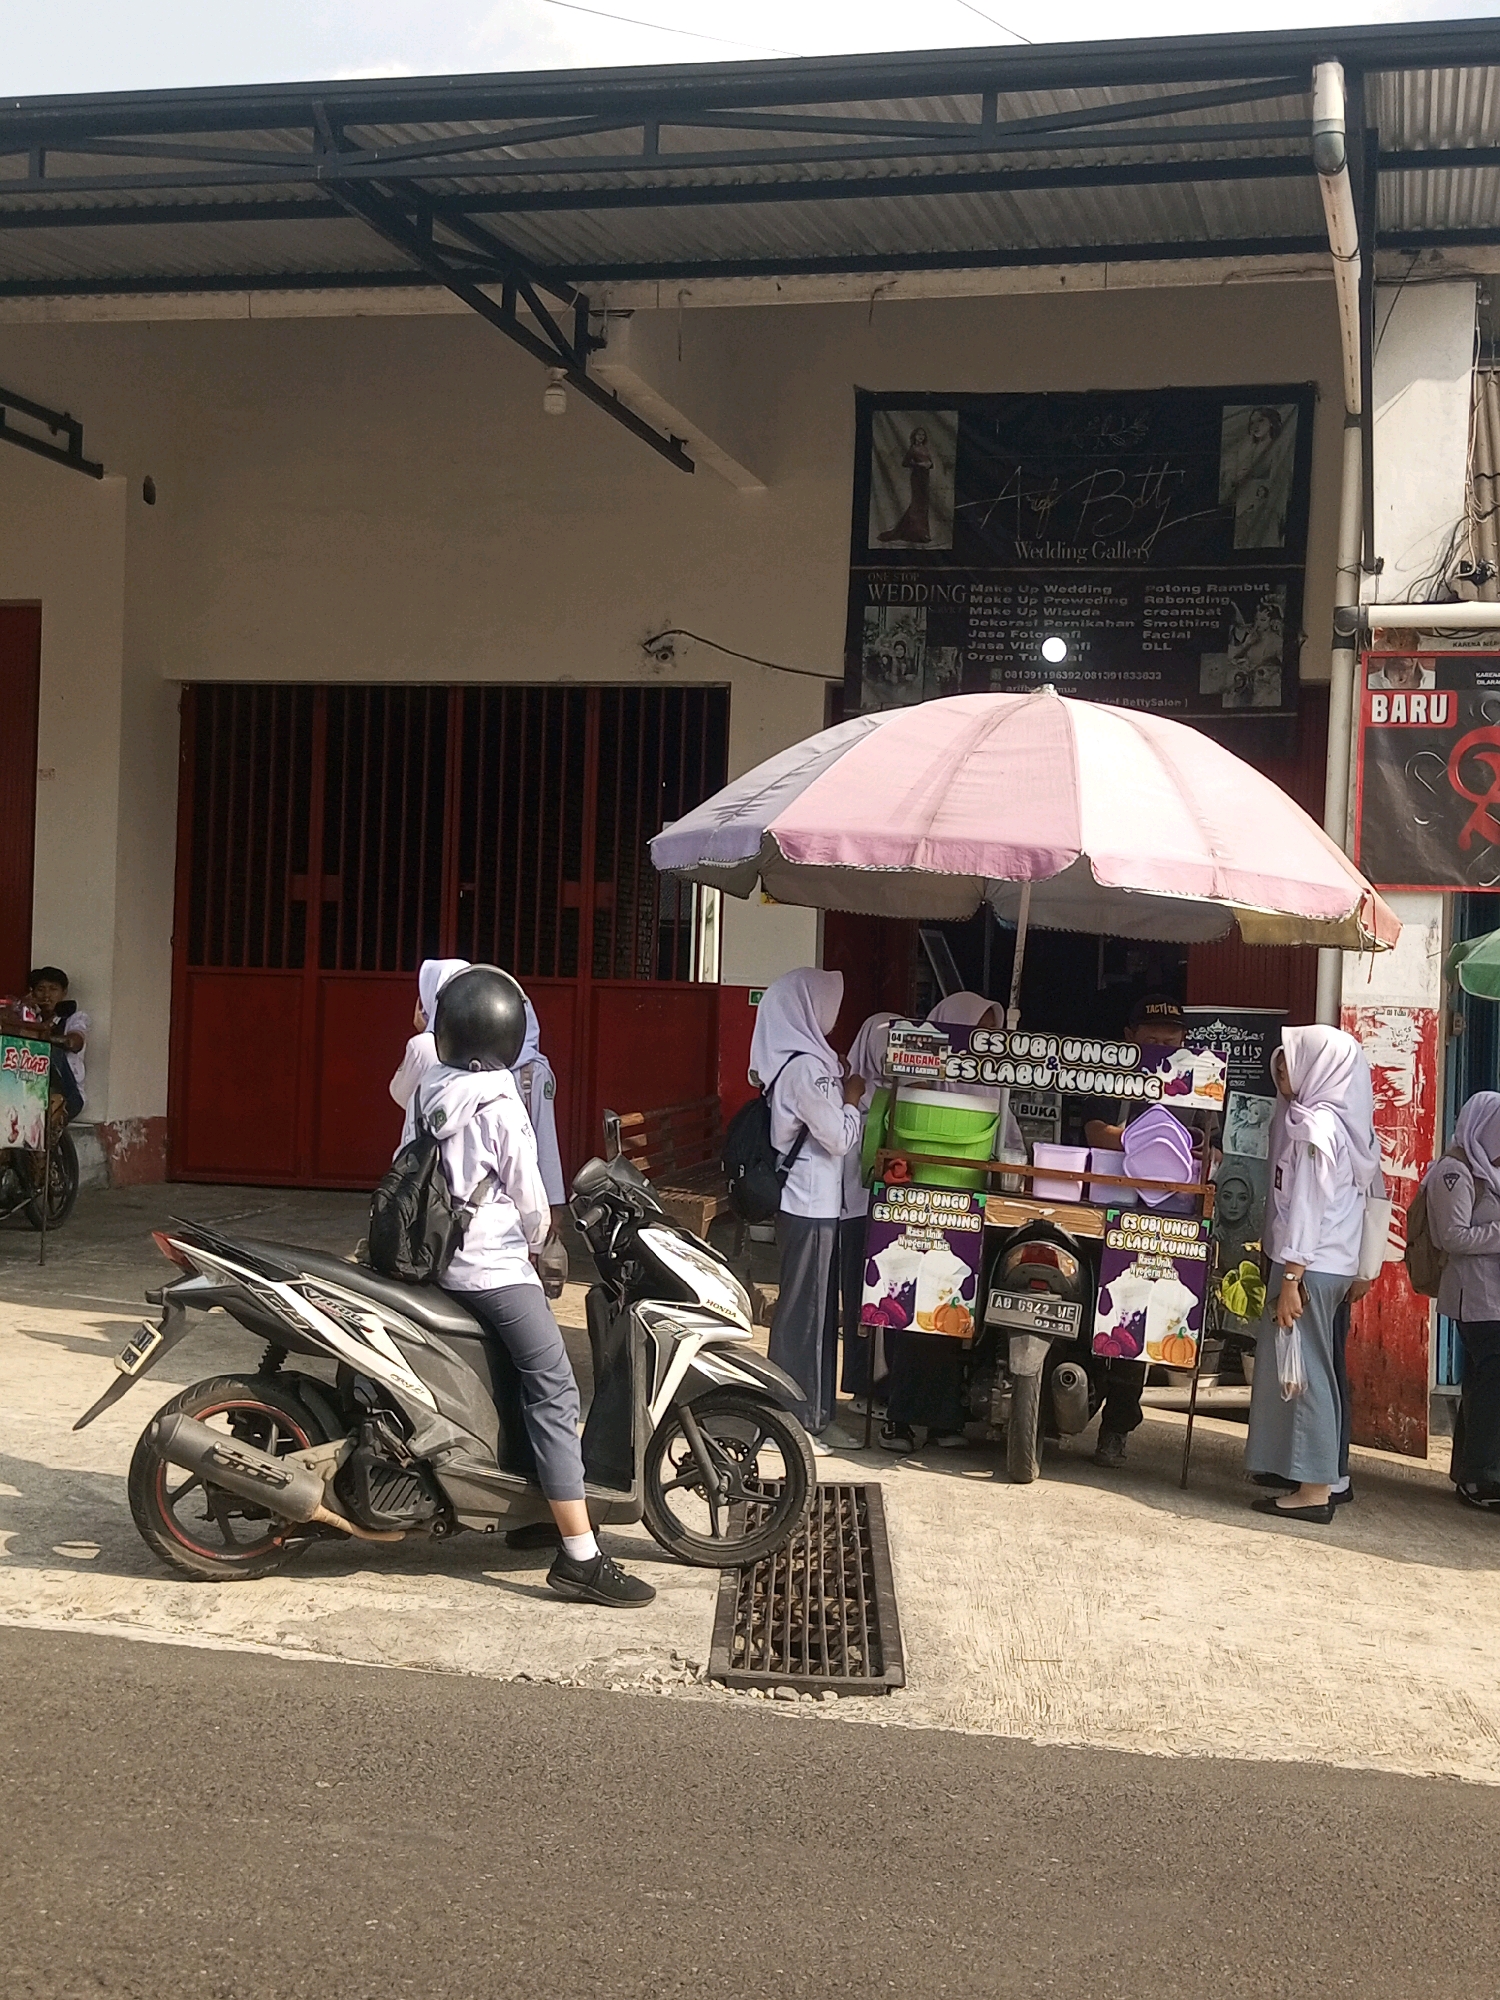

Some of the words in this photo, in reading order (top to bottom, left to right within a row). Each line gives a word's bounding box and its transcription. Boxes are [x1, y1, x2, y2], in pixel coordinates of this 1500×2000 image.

[1014, 540, 1088, 563] Wedding
[1091, 540, 1151, 564] Gallery
[867, 572, 888, 581] ONE
[893, 572, 920, 582] STOP
[868, 583, 968, 603] WEDDING
[970, 584, 1013, 593] Make
[1018, 584, 1040, 595] Up
[1043, 584, 1113, 595] Wedding
[1145, 584, 1202, 595] Potong
[1206, 582, 1270, 593] Rambut
[969, 595, 1013, 604] Make
[1017, 595, 1039, 606] Up
[1144, 595, 1231, 605] Rebonding
[969, 606, 1012, 616] Make
[1016, 606, 1038, 618] Up
[1043, 607, 1101, 617] Wisuda
[968, 618, 1038, 627] Dekorasi
[1043, 618, 1136, 628] Pernikahan
[1142, 618, 1220, 629] Smothing
[968, 630, 1006, 639] Jasa
[1142, 630, 1191, 639] Facial
[967, 641, 1005, 650] Jasa
[1142, 642, 1172, 651] DLL
[1371, 693, 1449, 725] BARU
[891, 1032, 902, 1042] 04
[972, 1031, 1006, 1053] ES
[1010, 1034, 1058, 1058] UBI
[1062, 1038, 1138, 1067] UNGU
[1221, 1041, 1263, 1059] Betty
[892, 1051, 941, 1066] PEDAGANG
[1045, 1055, 1060, 1072] &
[945, 1057, 978, 1080] ES
[981, 1060, 1054, 1087] LABU
[1057, 1068, 1162, 1099] KUNING
[1020, 1104, 1058, 1119] BUKA
[888, 1187, 906, 1203] ES
[907, 1189, 930, 1206] UBI
[932, 1193, 969, 1210] UNGU
[873, 1205, 891, 1220] ES
[892, 1206, 928, 1223] LABU
[929, 1211, 980, 1230] KUNING
[1122, 1214, 1138, 1230] ES
[1139, 1217, 1161, 1234] UBI
[1163, 1220, 1199, 1238] UNGU
[1108, 1231, 1125, 1247] ES
[1125, 1233, 1158, 1251] LABU
[1160, 1239, 1207, 1258] KUNING
[706, 1298, 738, 1318] HONDA
